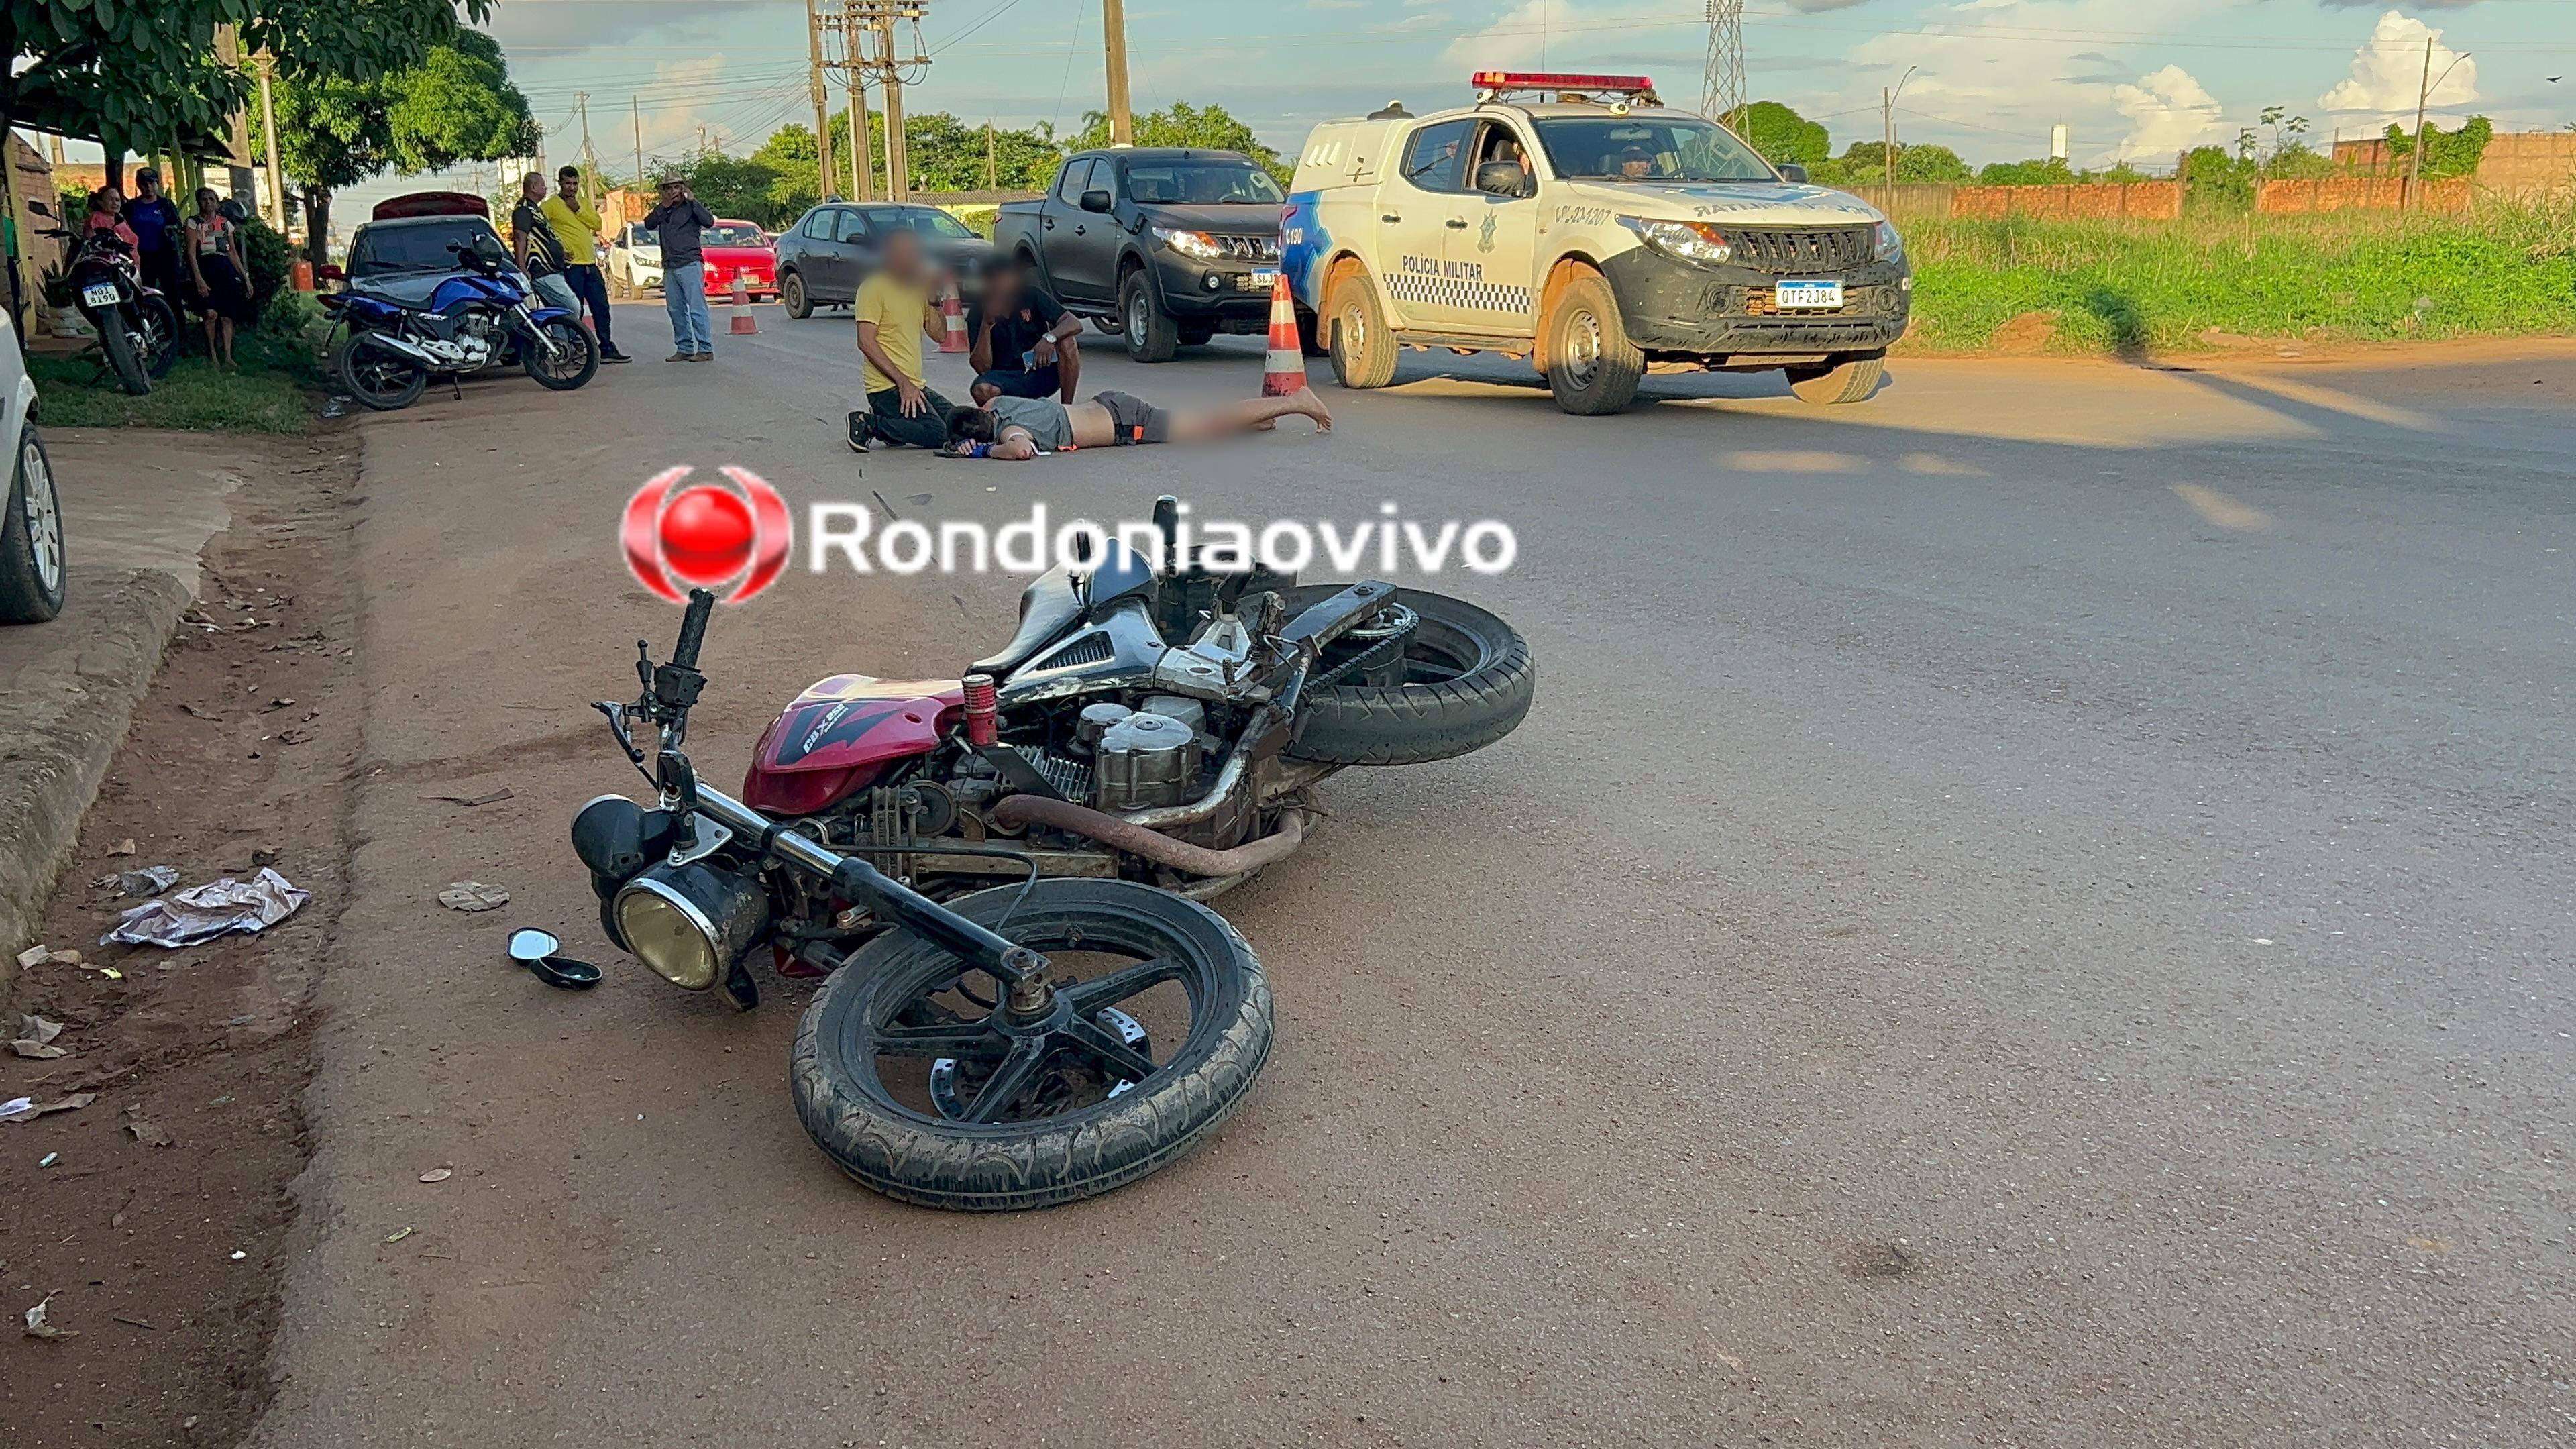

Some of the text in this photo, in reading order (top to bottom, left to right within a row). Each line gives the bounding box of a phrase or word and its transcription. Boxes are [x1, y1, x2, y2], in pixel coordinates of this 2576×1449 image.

[1402, 252, 1483, 281] POLÍCIA MILITAR
[1256, 274, 1277, 283] SLJ
